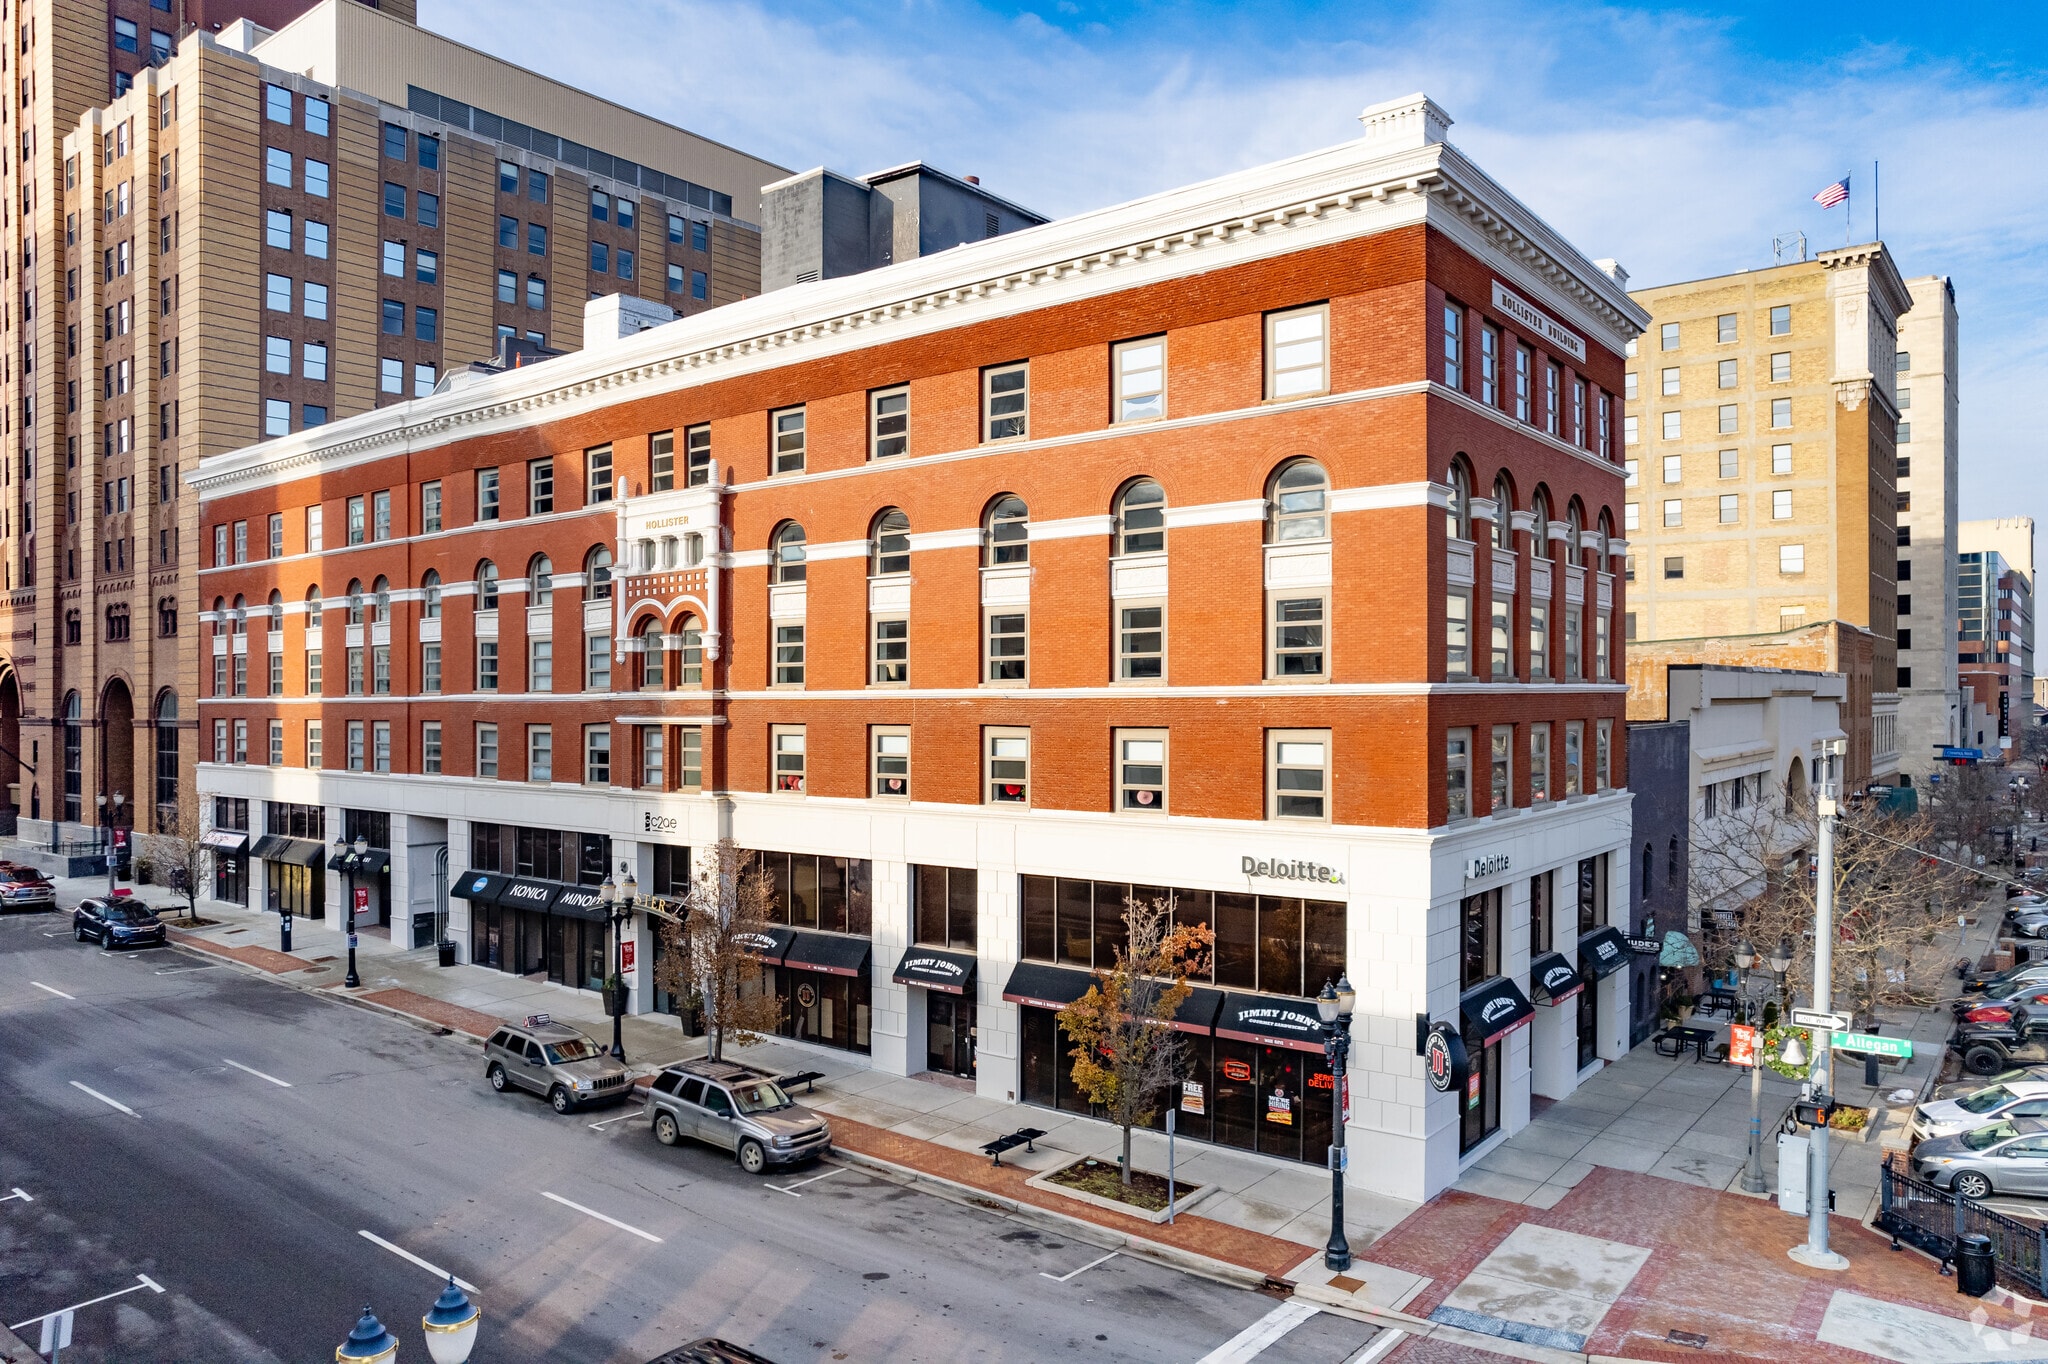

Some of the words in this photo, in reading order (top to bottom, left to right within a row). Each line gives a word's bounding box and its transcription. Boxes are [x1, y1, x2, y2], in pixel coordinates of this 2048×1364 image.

[1502, 294, 1543, 330] HOLLISTER
[1548, 325, 1578, 352] BUILDING
[645, 516, 689, 529] HOLLISTER
[650, 816, 677, 829] c2ae
[509, 884, 549, 901] KONICA
[560, 892, 601, 907] MINO
[904, 958, 935, 970] JIMMY
[934, 960, 963, 976] JOHN'S
[1238, 1009, 1281, 1021] JIMMY
[1281, 1010, 1321, 1031] JOHN'S
[1845, 1034, 1898, 1052] Allegan
[1308, 1078, 1334, 1090] DELIV
[1313, 1072, 1334, 1082] SERIO
[1182, 1081, 1204, 1093] FREE
[1817, 1108, 1825, 1124] 6
